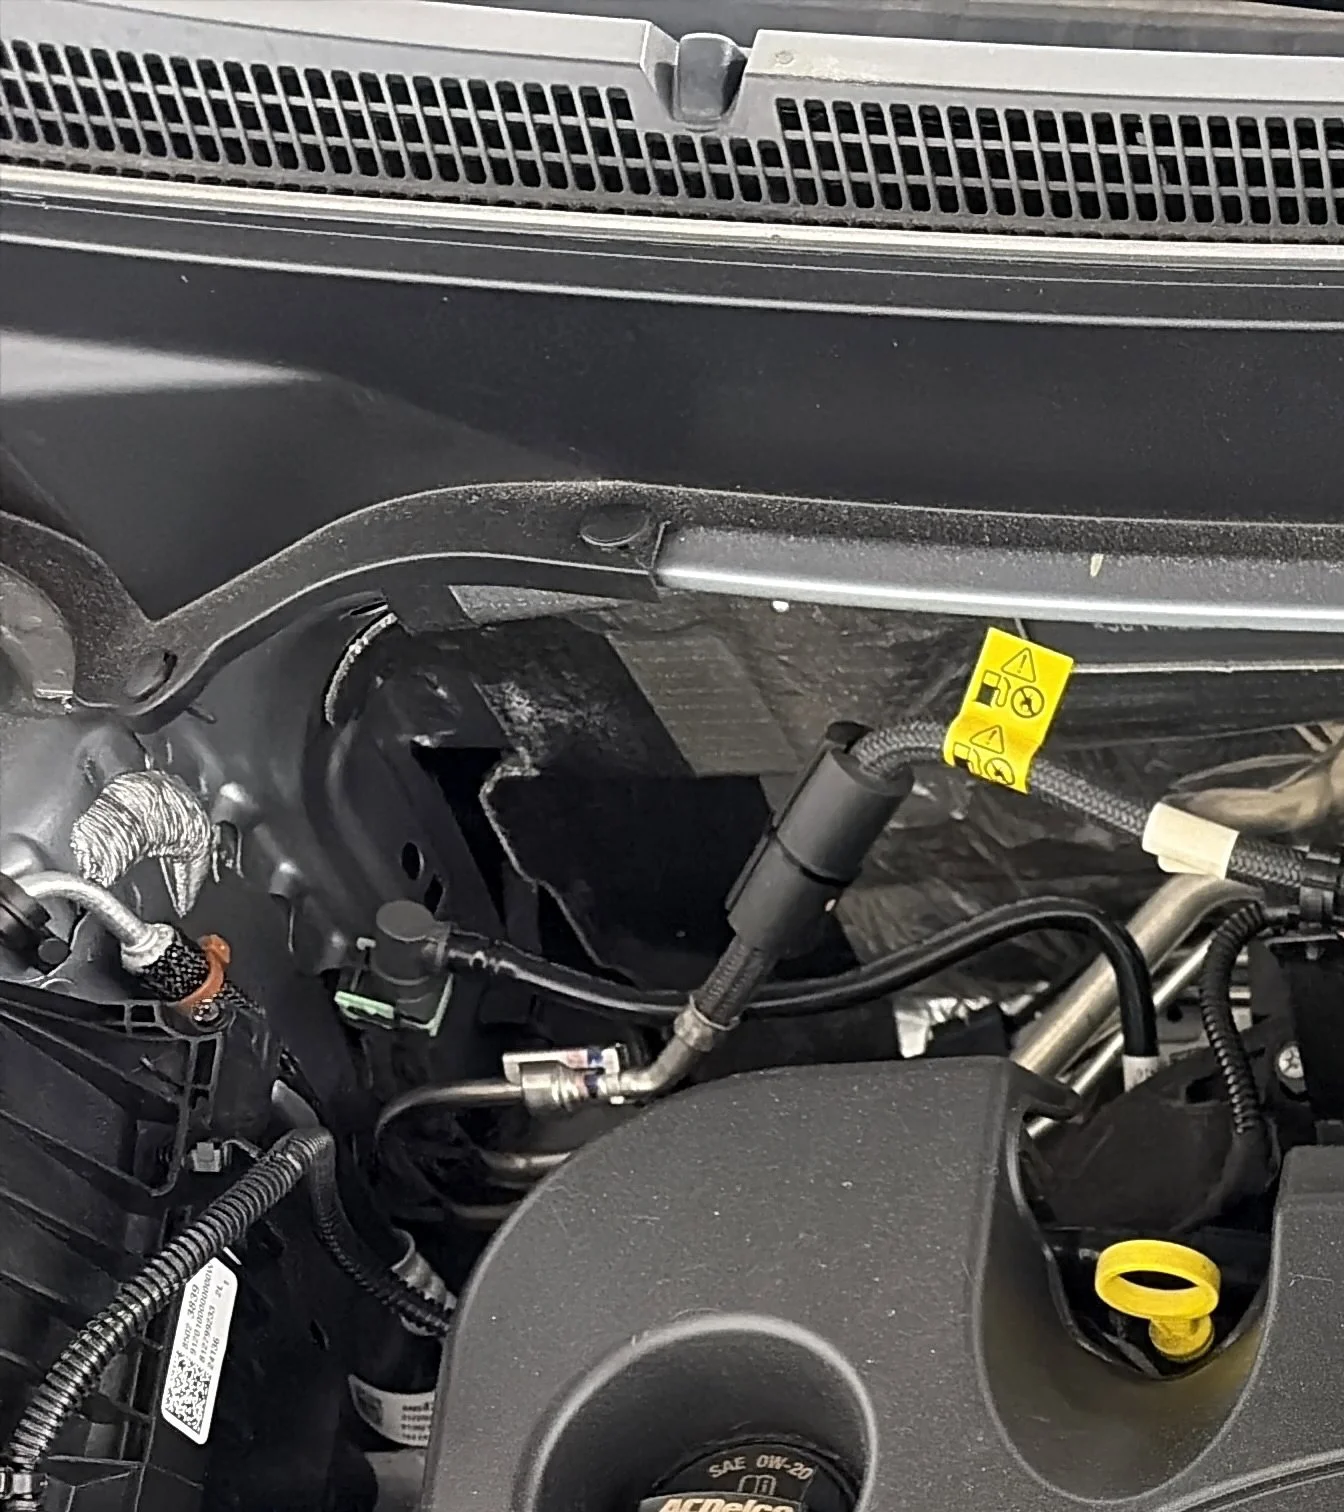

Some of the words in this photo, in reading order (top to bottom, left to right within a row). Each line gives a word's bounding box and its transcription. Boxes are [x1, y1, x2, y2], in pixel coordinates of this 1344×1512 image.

[187, 1284, 200, 1319] 3839
[709, 1456, 746, 1478] SAE
[756, 1454, 814, 1480] 0W-20
